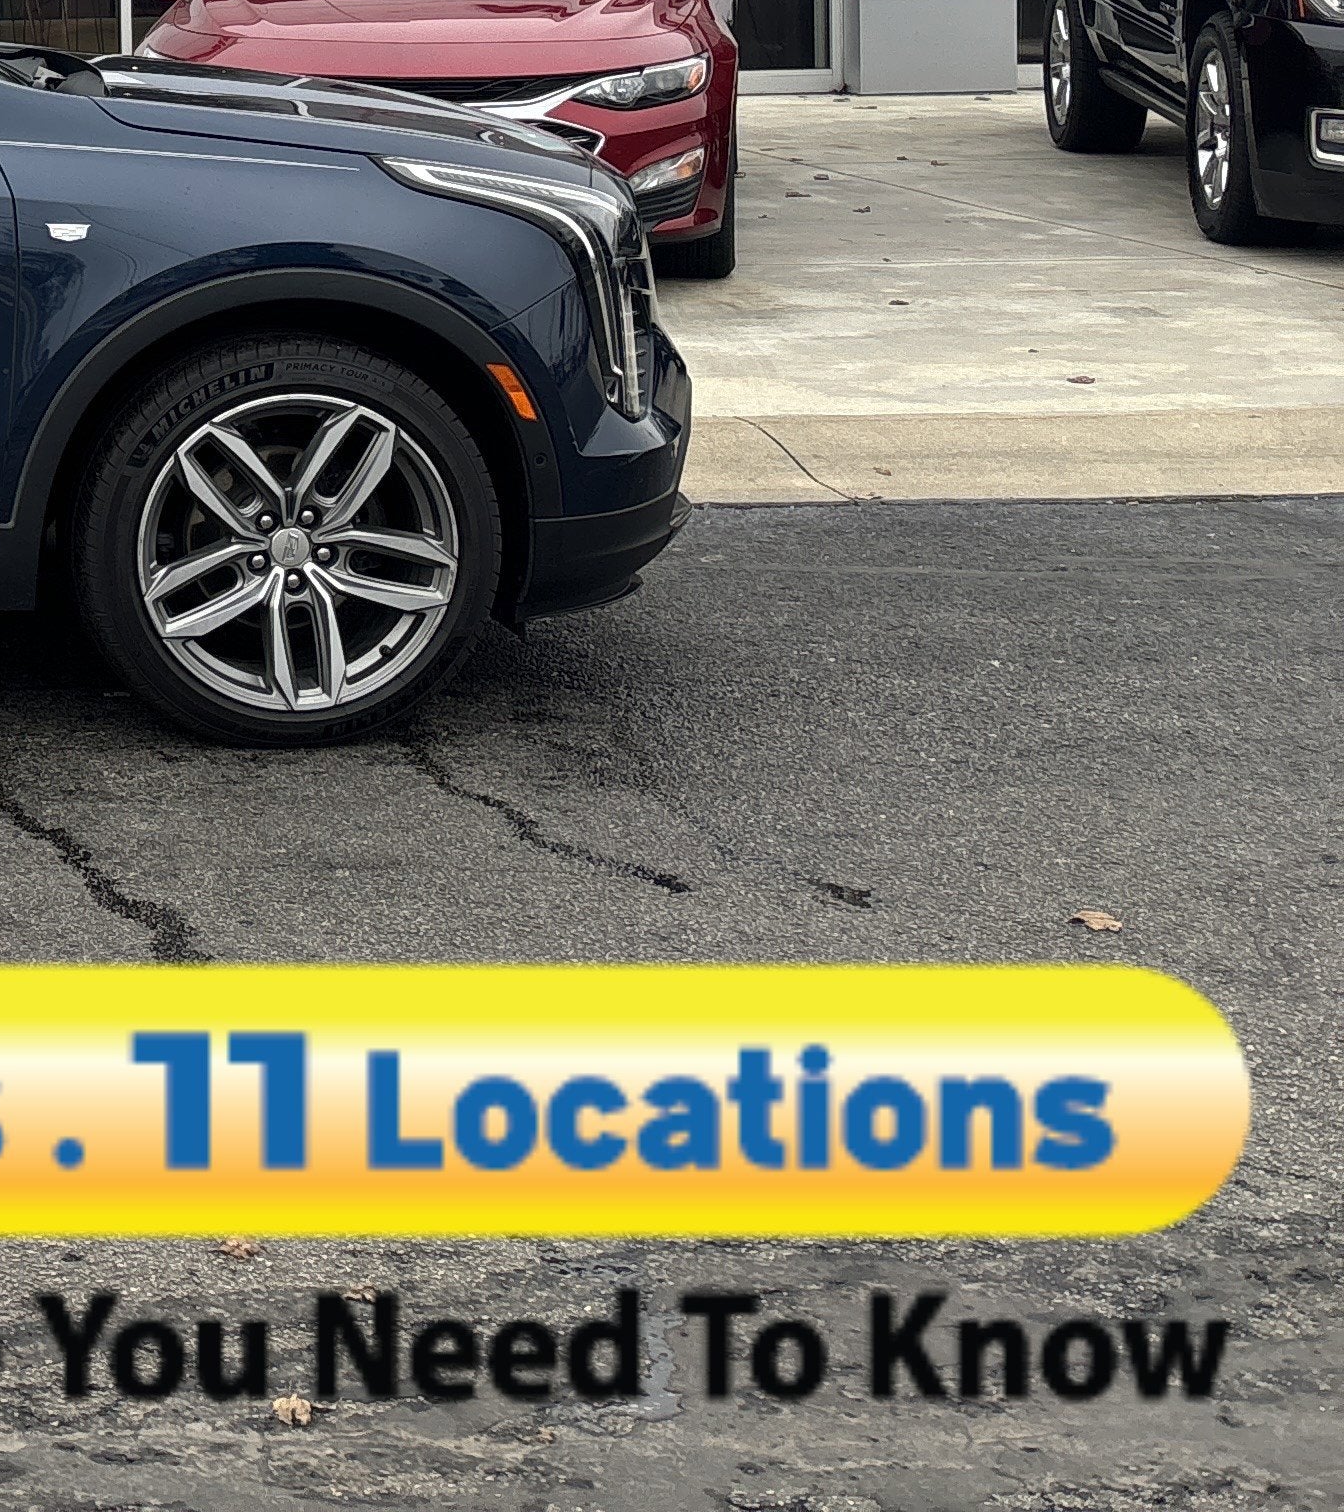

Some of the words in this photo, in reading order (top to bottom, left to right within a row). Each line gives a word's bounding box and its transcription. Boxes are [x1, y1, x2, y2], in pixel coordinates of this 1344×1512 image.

[285, 361, 336, 373] PRIMACY
[340, 366, 370, 382] TOUR
[151, 364, 267, 440] MICHELIN
